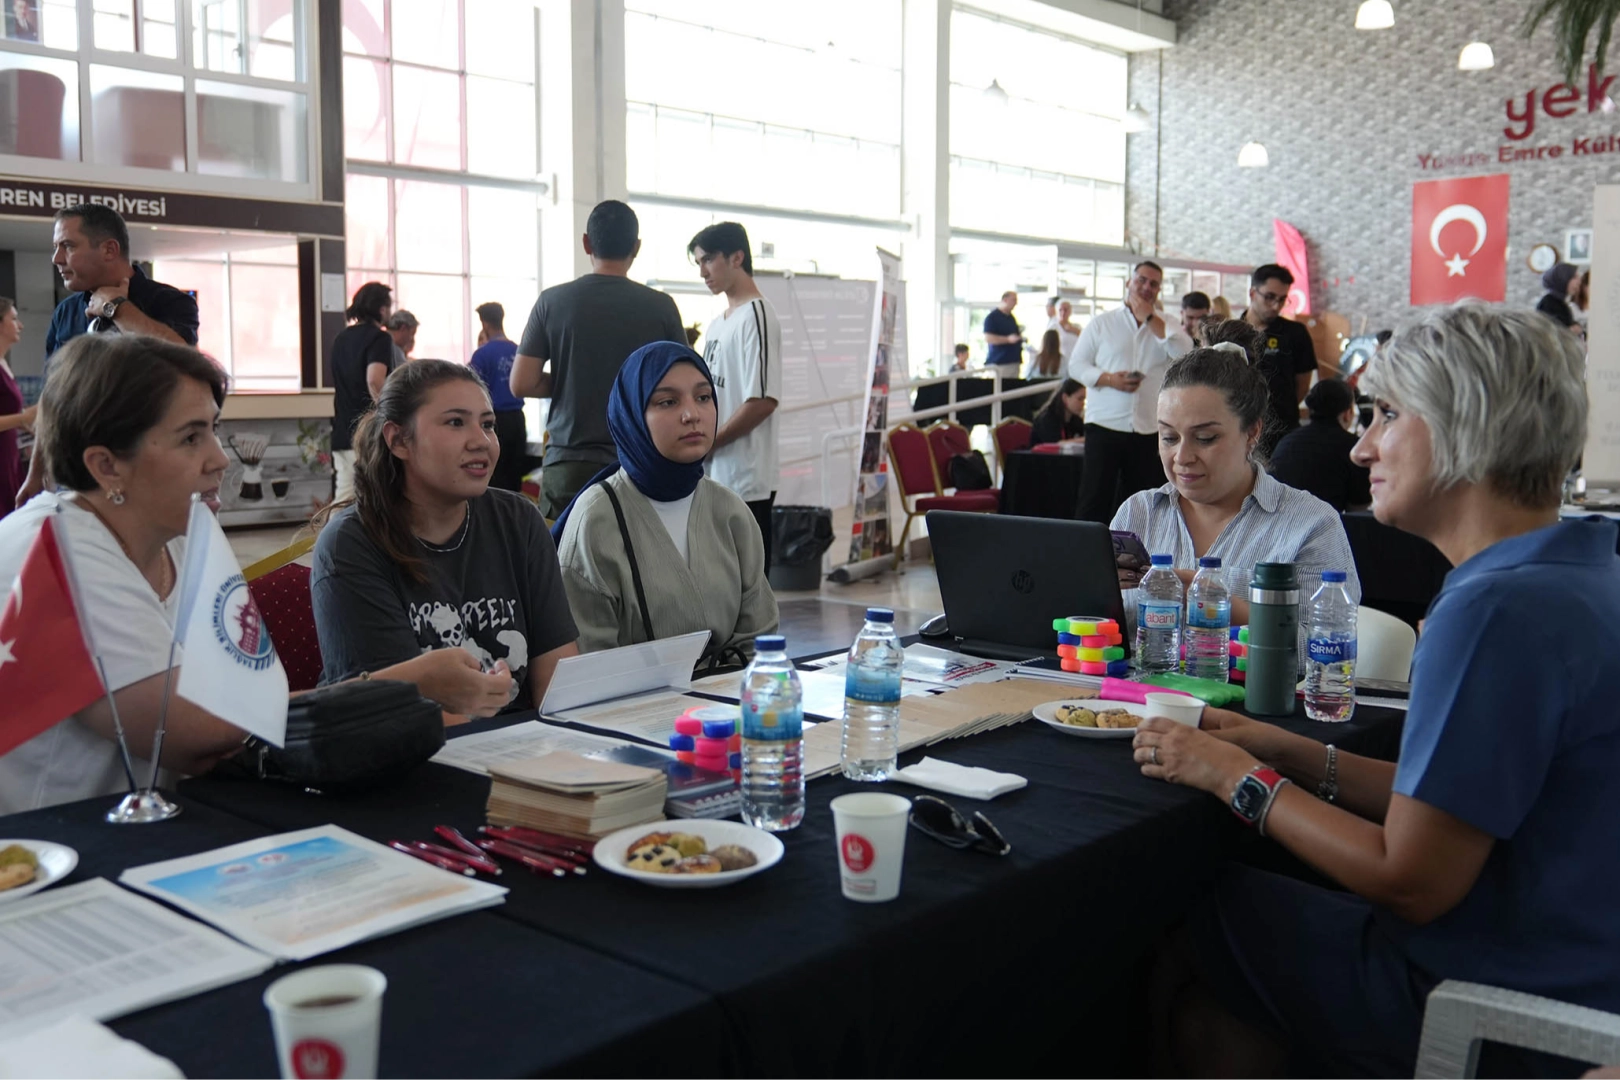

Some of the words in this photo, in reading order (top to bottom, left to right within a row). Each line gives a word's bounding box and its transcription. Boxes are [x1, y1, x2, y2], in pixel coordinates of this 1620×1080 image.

[1504, 62, 1618, 140] yek
[1498, 145, 1563, 163] Emre
[0, 188, 44, 207] REN
[1146, 612, 1175, 624] abant
[1310, 643, 1342, 655] SIRMA
